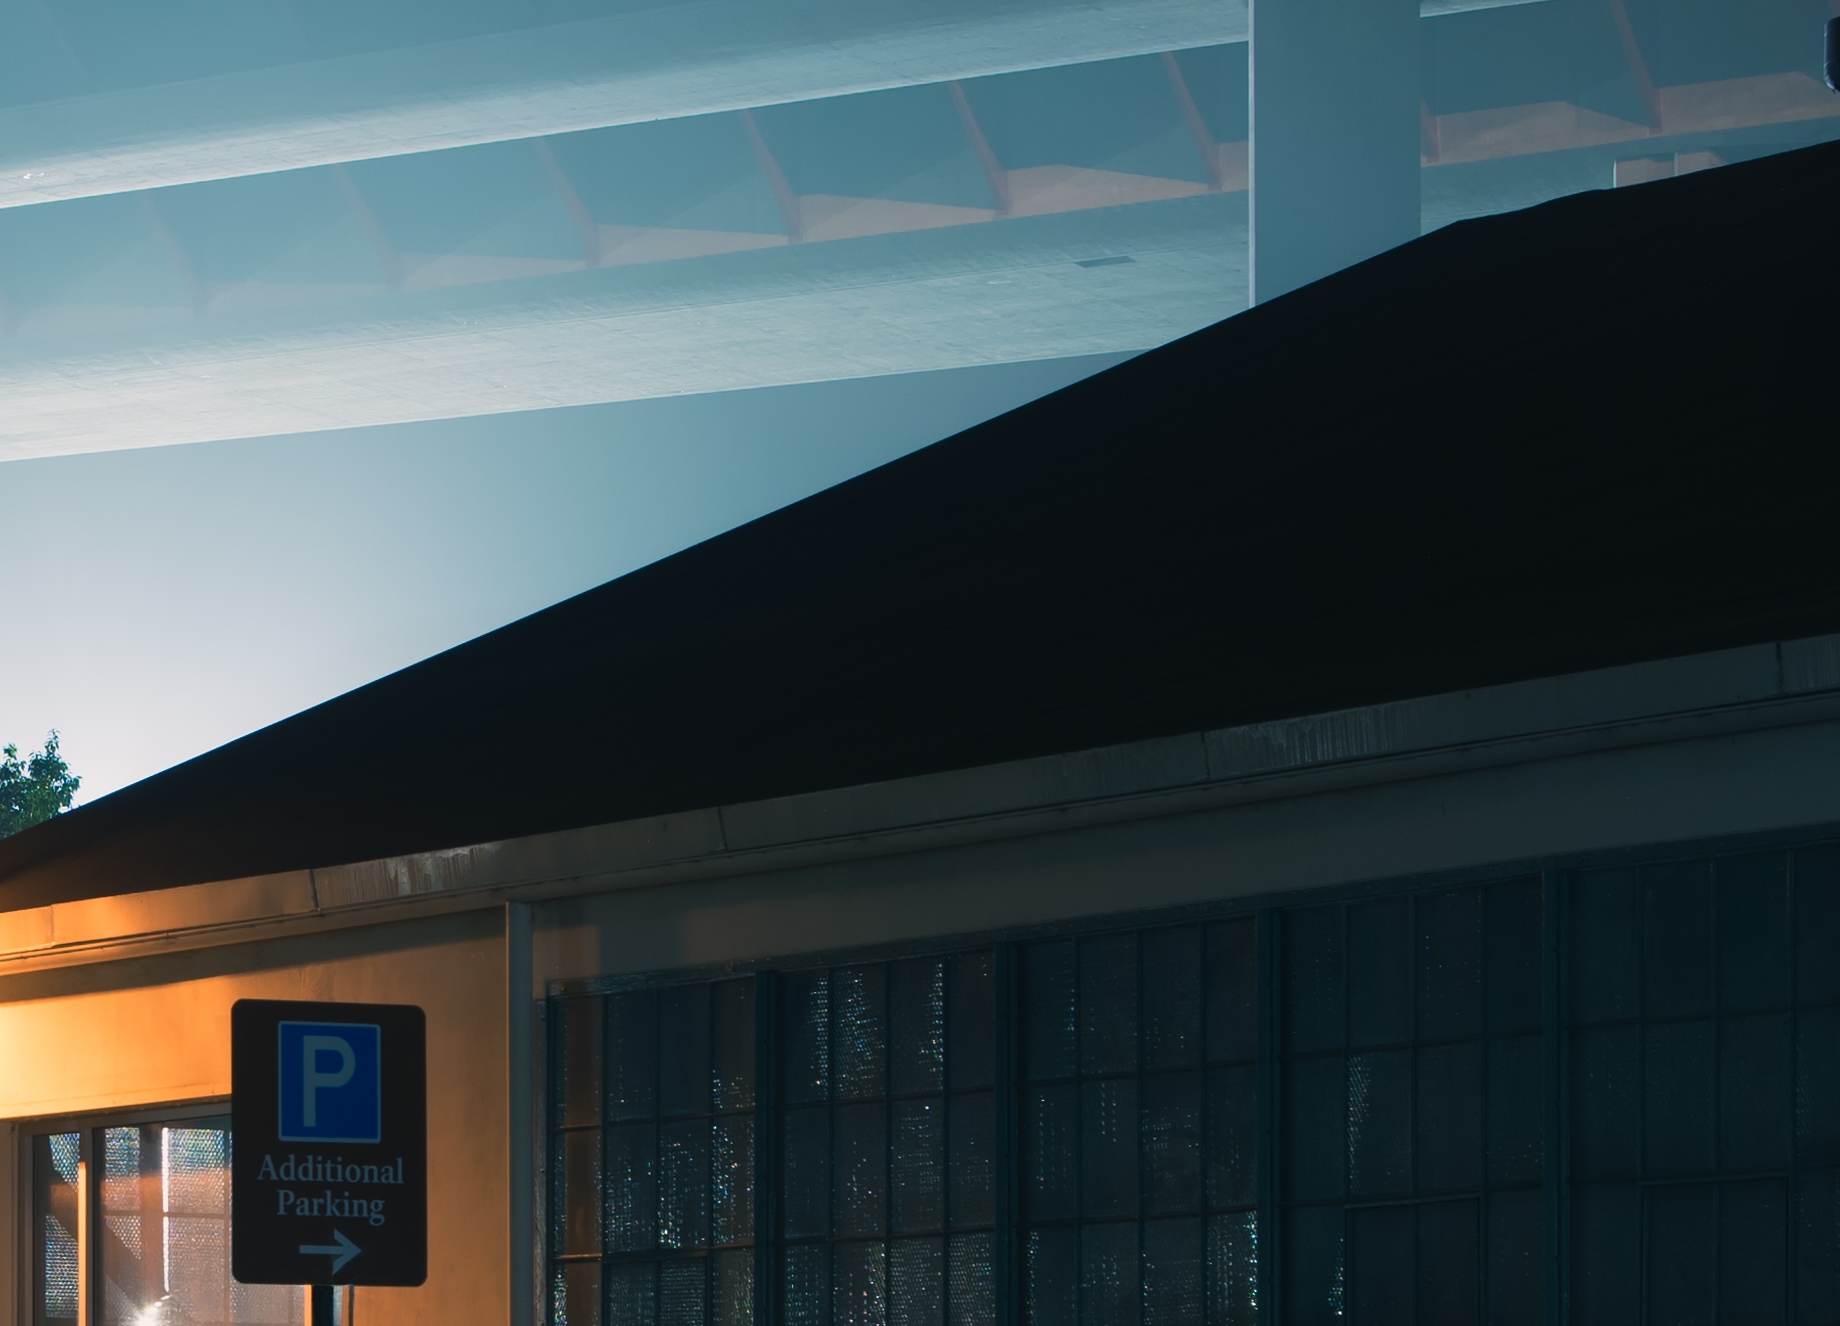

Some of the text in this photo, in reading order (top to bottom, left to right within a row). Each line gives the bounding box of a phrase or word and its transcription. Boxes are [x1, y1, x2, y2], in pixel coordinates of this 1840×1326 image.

[303, 1035, 356, 1128] P
[257, 1154, 405, 1184] Additional
[277, 1189, 385, 1226] Parking
